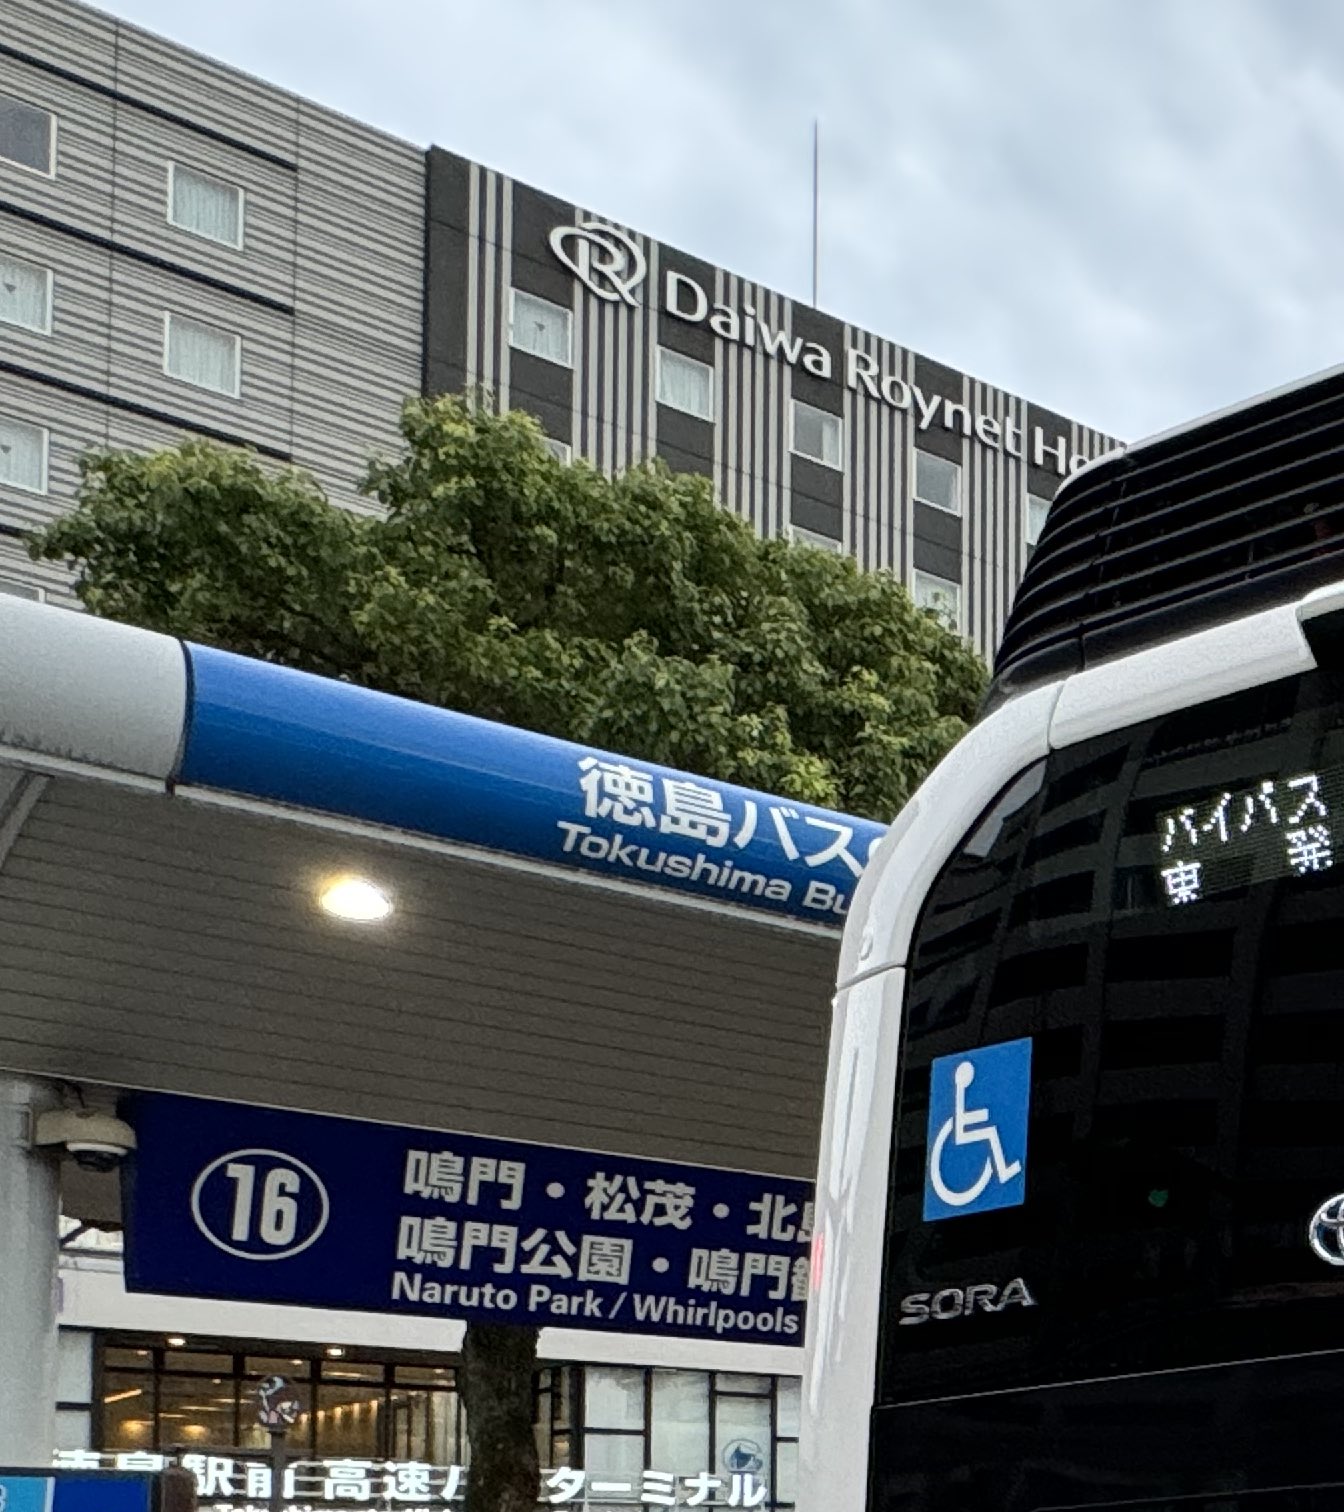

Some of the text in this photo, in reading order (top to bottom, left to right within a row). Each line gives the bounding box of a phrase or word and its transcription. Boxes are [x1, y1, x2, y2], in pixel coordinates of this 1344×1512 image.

[666, 270, 832, 379] Daiwa
[847, 347, 1024, 457] Roynet
[578, 757, 879, 879] 徳島バス
[1161, 774, 1327, 852] バイパス
[557, 821, 792, 902] Tokushima
[225, 1164, 299, 1248] 16
[403, 1150, 815, 1243] 鳴門・松茂・北
[392, 1271, 518, 1311] Naruto
[528, 1284, 604, 1318] Park
[633, 1293, 799, 1334] Whirlpools
[899, 1276, 1038, 1326] SORA
